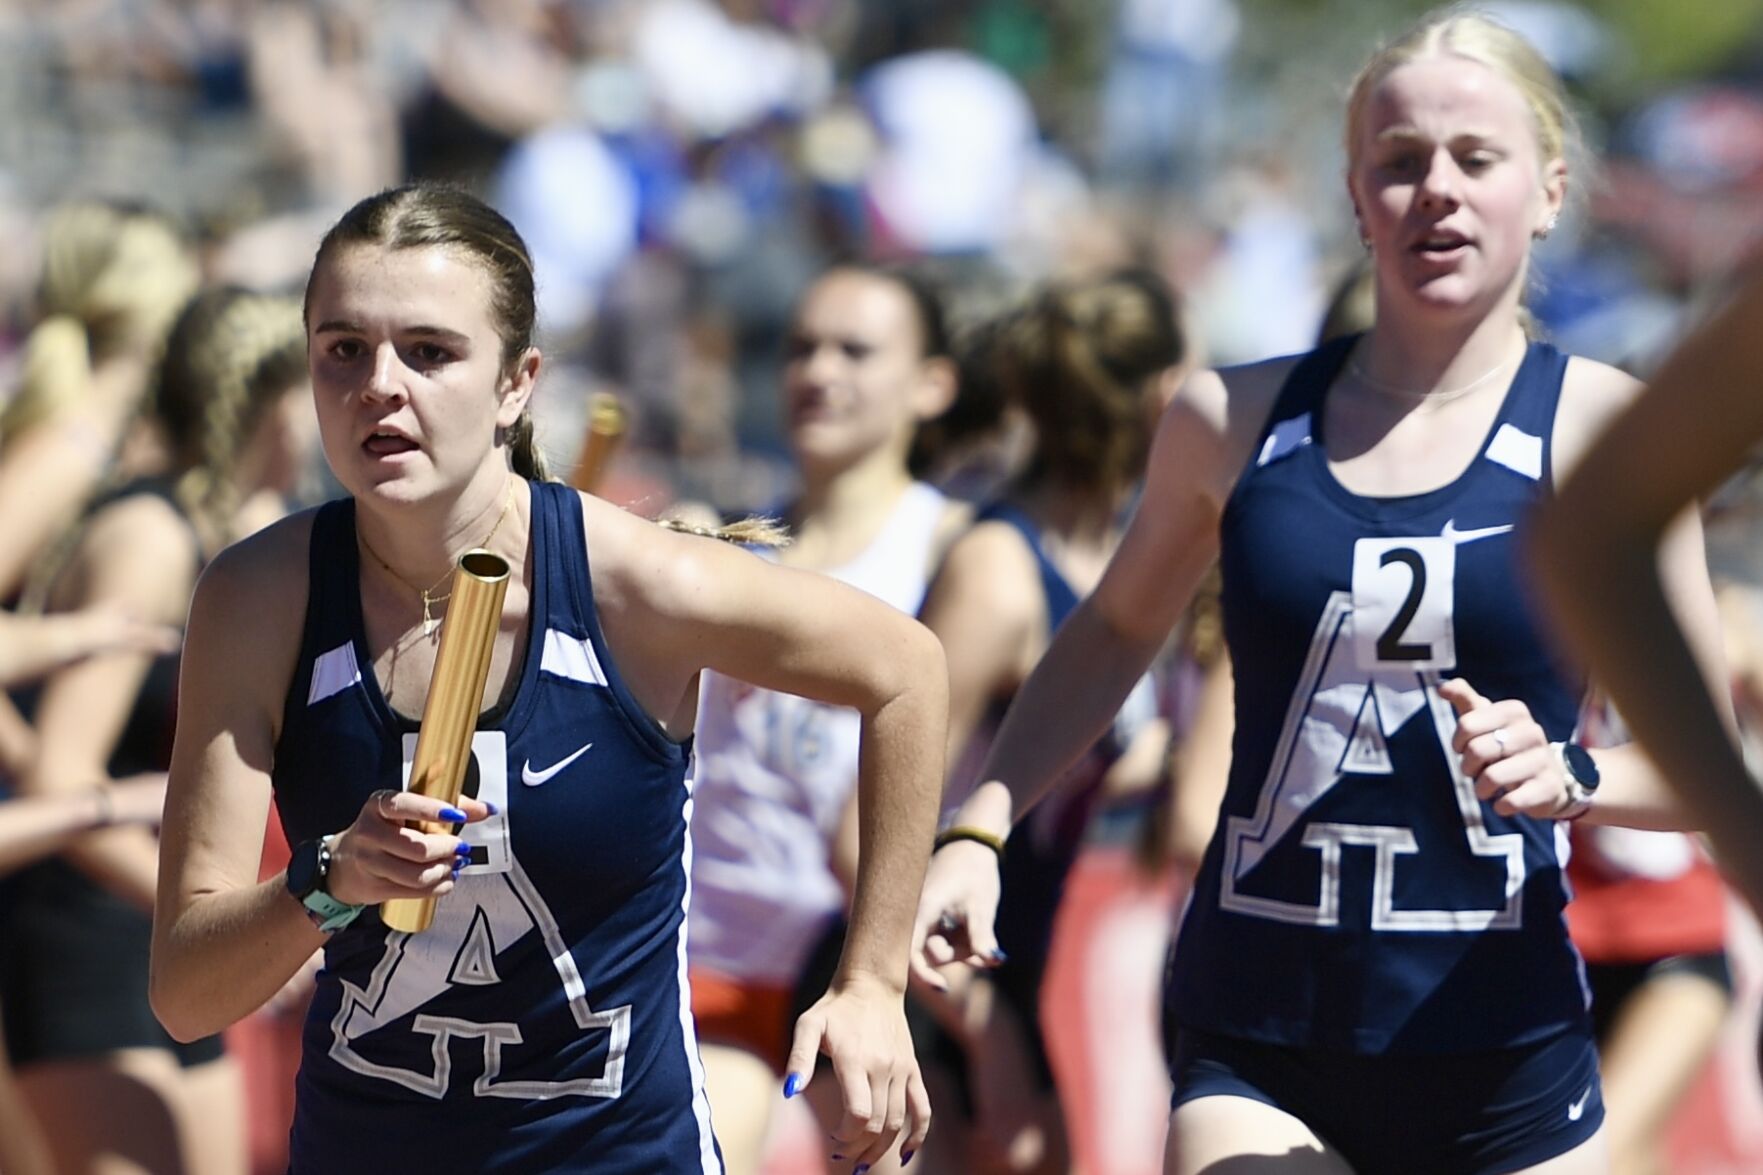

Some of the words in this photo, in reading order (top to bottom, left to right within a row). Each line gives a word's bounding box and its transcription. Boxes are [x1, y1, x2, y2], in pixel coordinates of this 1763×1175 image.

[1376, 547, 1433, 661] 2
[1219, 591, 1525, 931] A
[328, 848, 632, 1100] A
